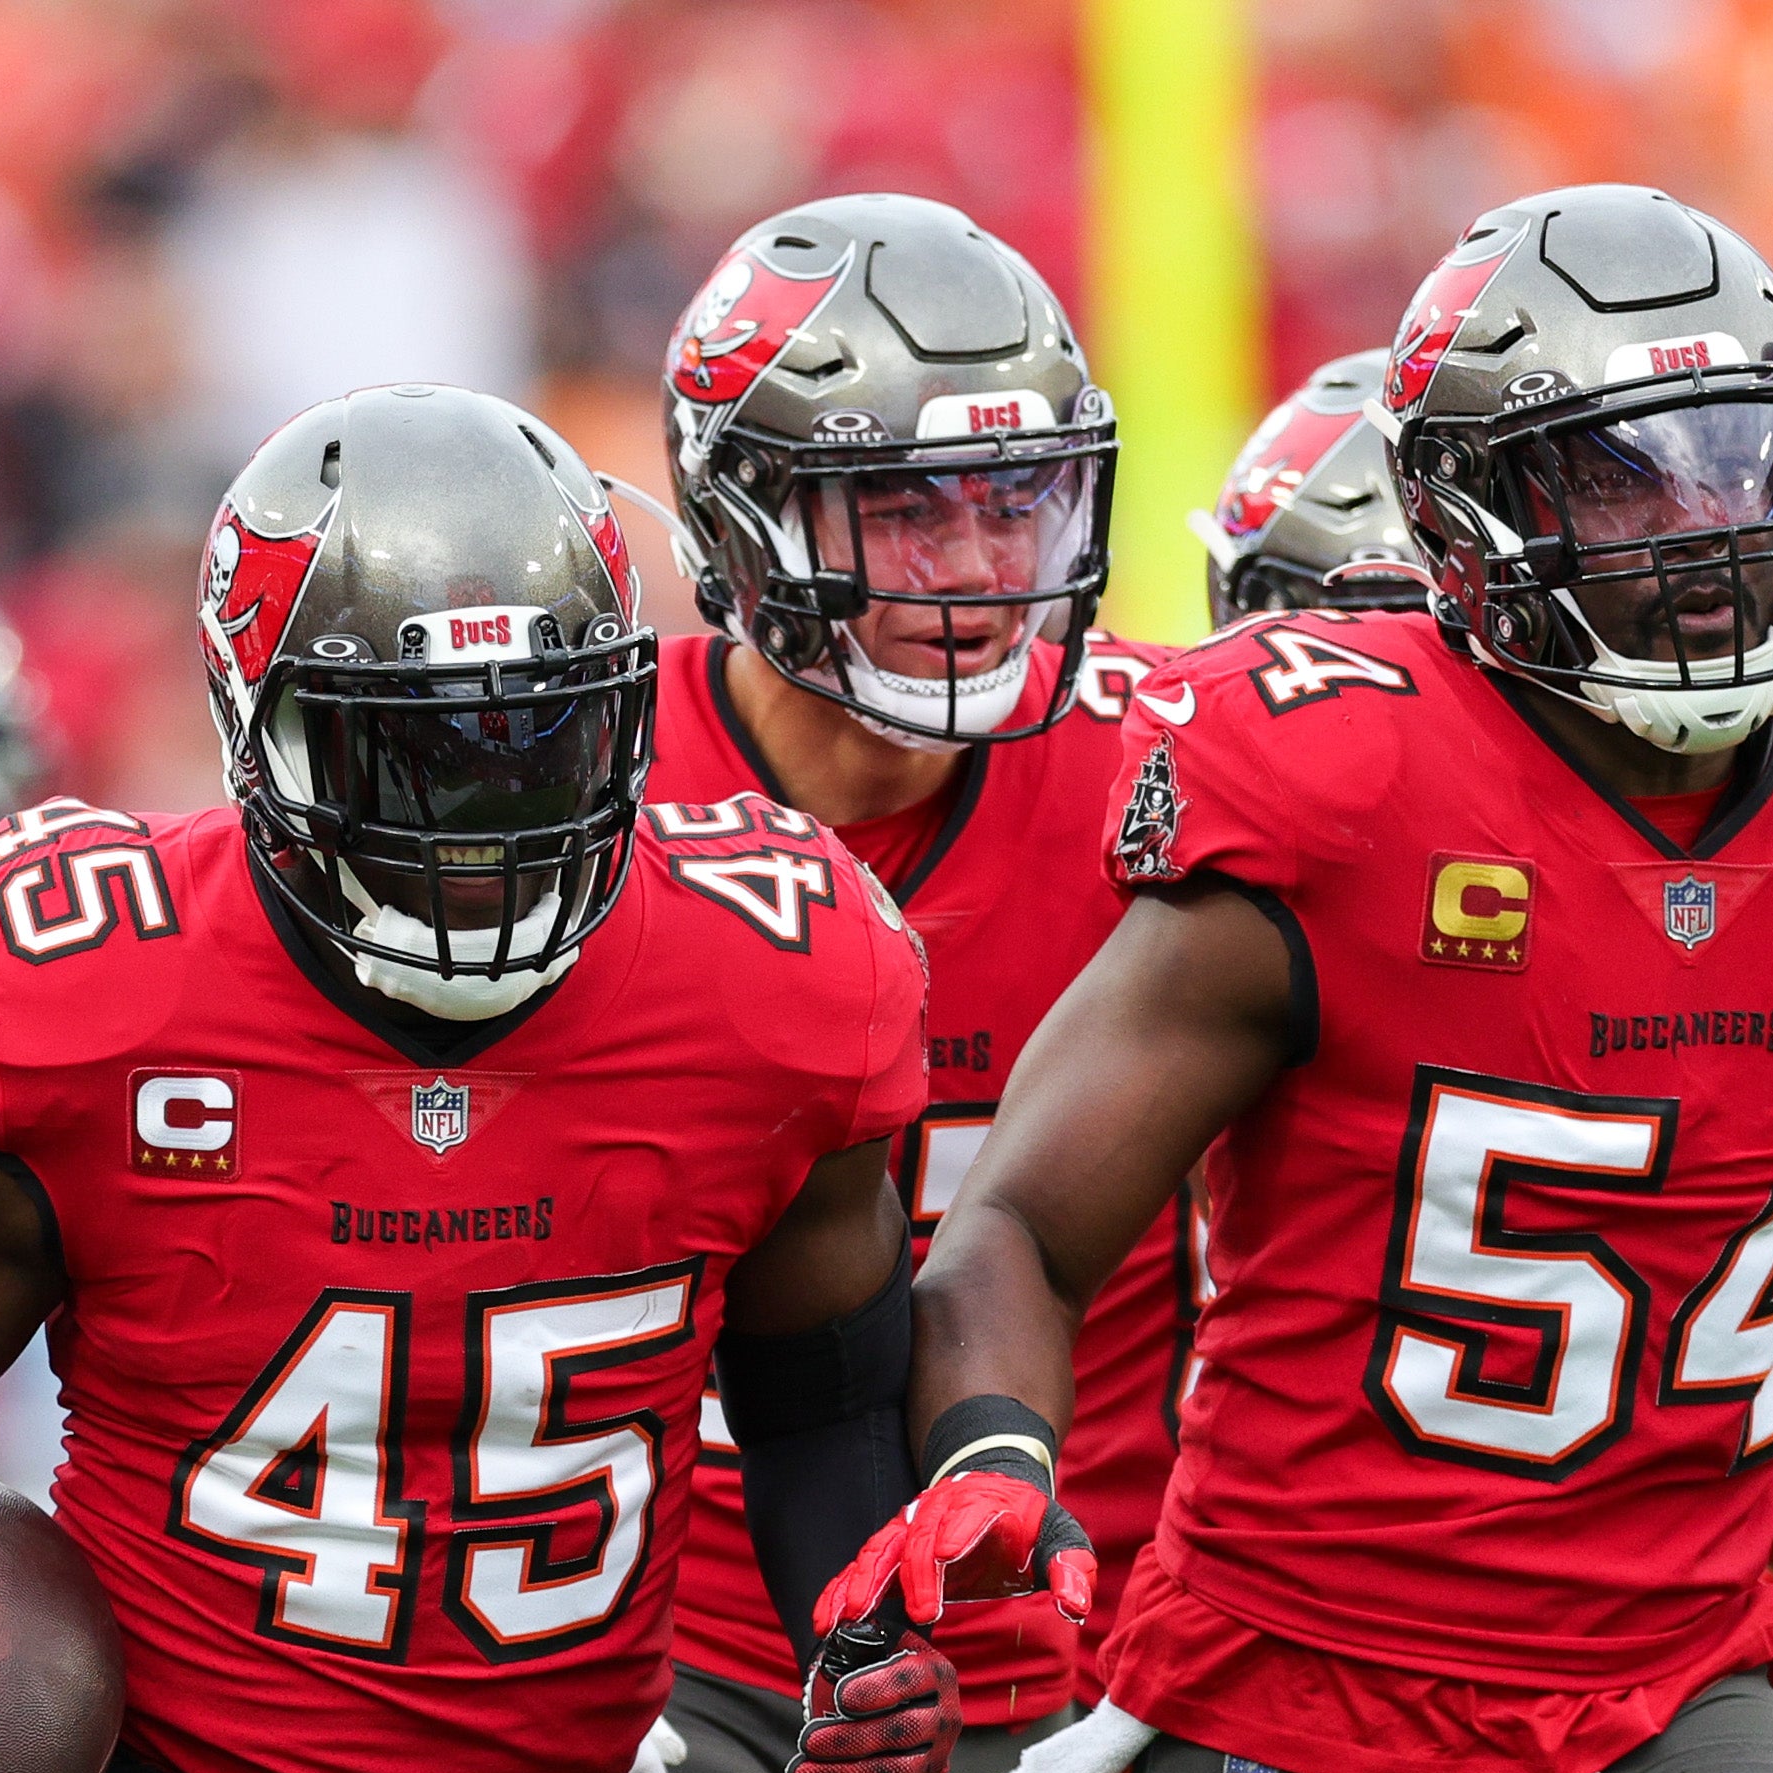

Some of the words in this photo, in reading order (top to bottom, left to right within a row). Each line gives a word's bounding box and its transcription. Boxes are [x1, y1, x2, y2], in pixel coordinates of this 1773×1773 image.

[1648, 341, 1711, 374] BUCS
[968, 401, 1022, 433] BUCS
[449, 614, 512, 649] BUCS
[1432, 862, 1529, 942] C
[1673, 906, 1708, 934] NFL
[136, 1076, 234, 1151] C
[421, 1112, 459, 1140] NFL
[329, 1196, 555, 1253] BUCCANEERS
[165, 1254, 706, 1666] 45
